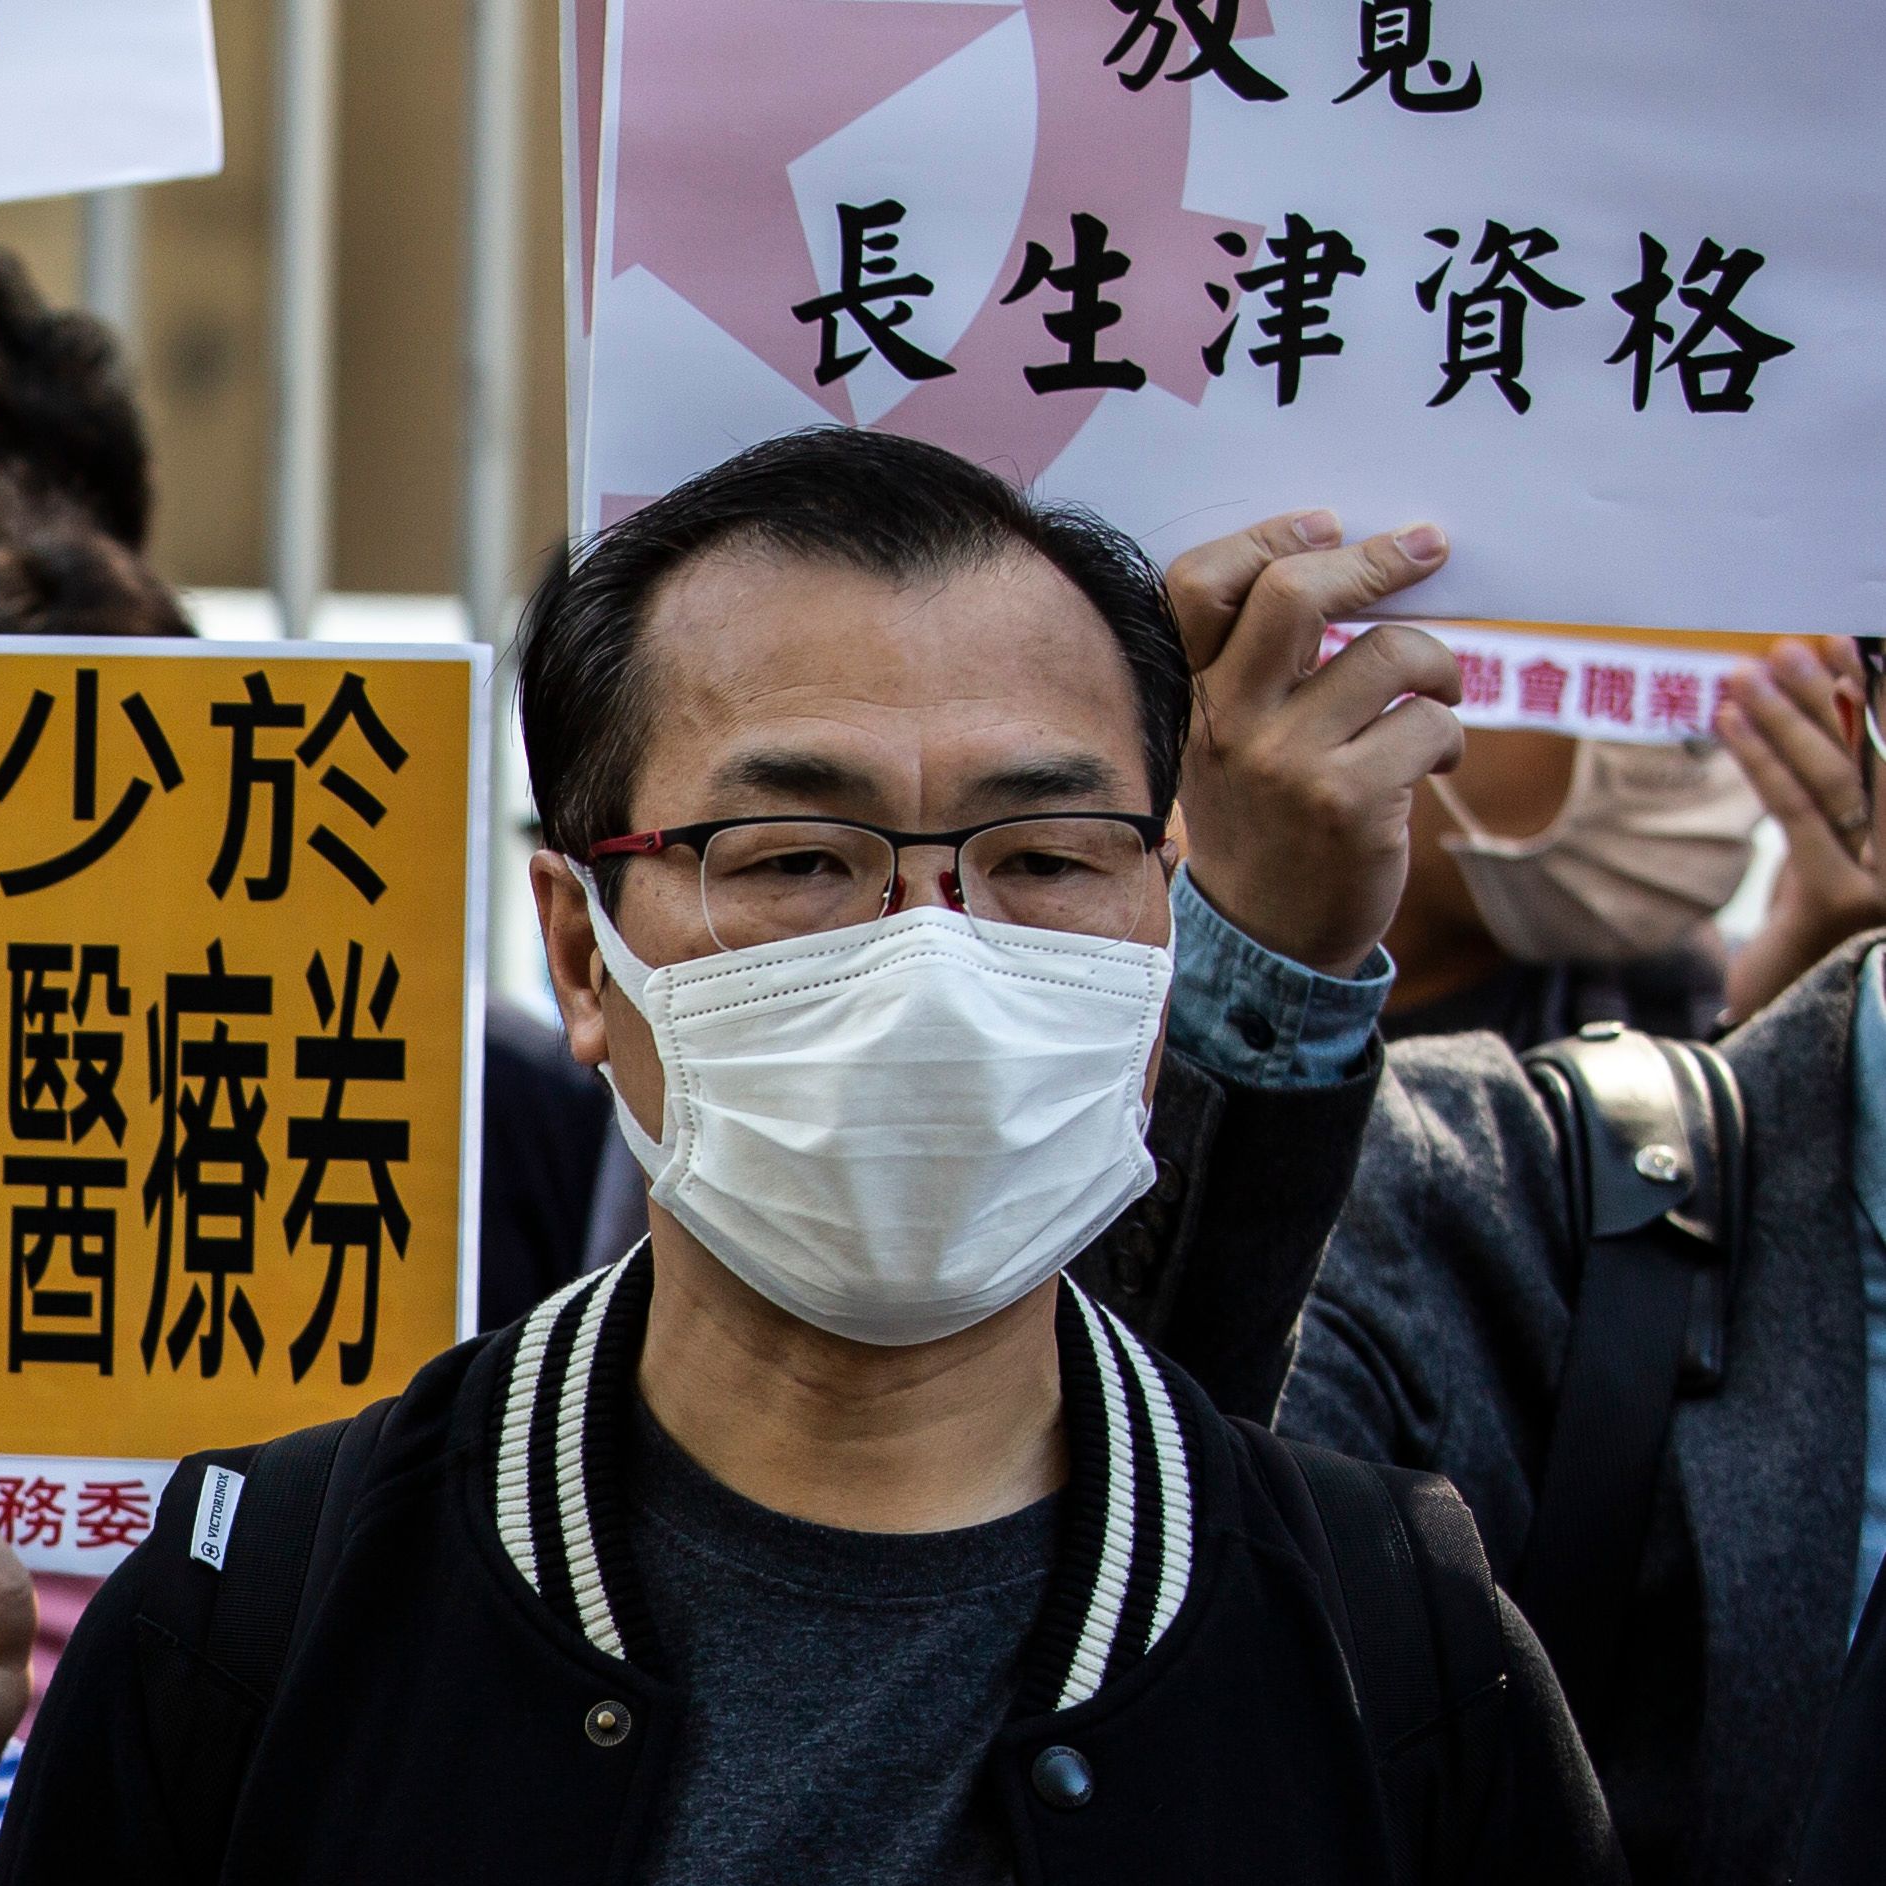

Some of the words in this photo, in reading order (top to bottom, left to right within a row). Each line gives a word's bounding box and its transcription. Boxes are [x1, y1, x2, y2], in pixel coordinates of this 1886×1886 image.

[792, 199, 1795, 415] 長生津資格
[207, 1471, 230, 1539] VICTORINOX
